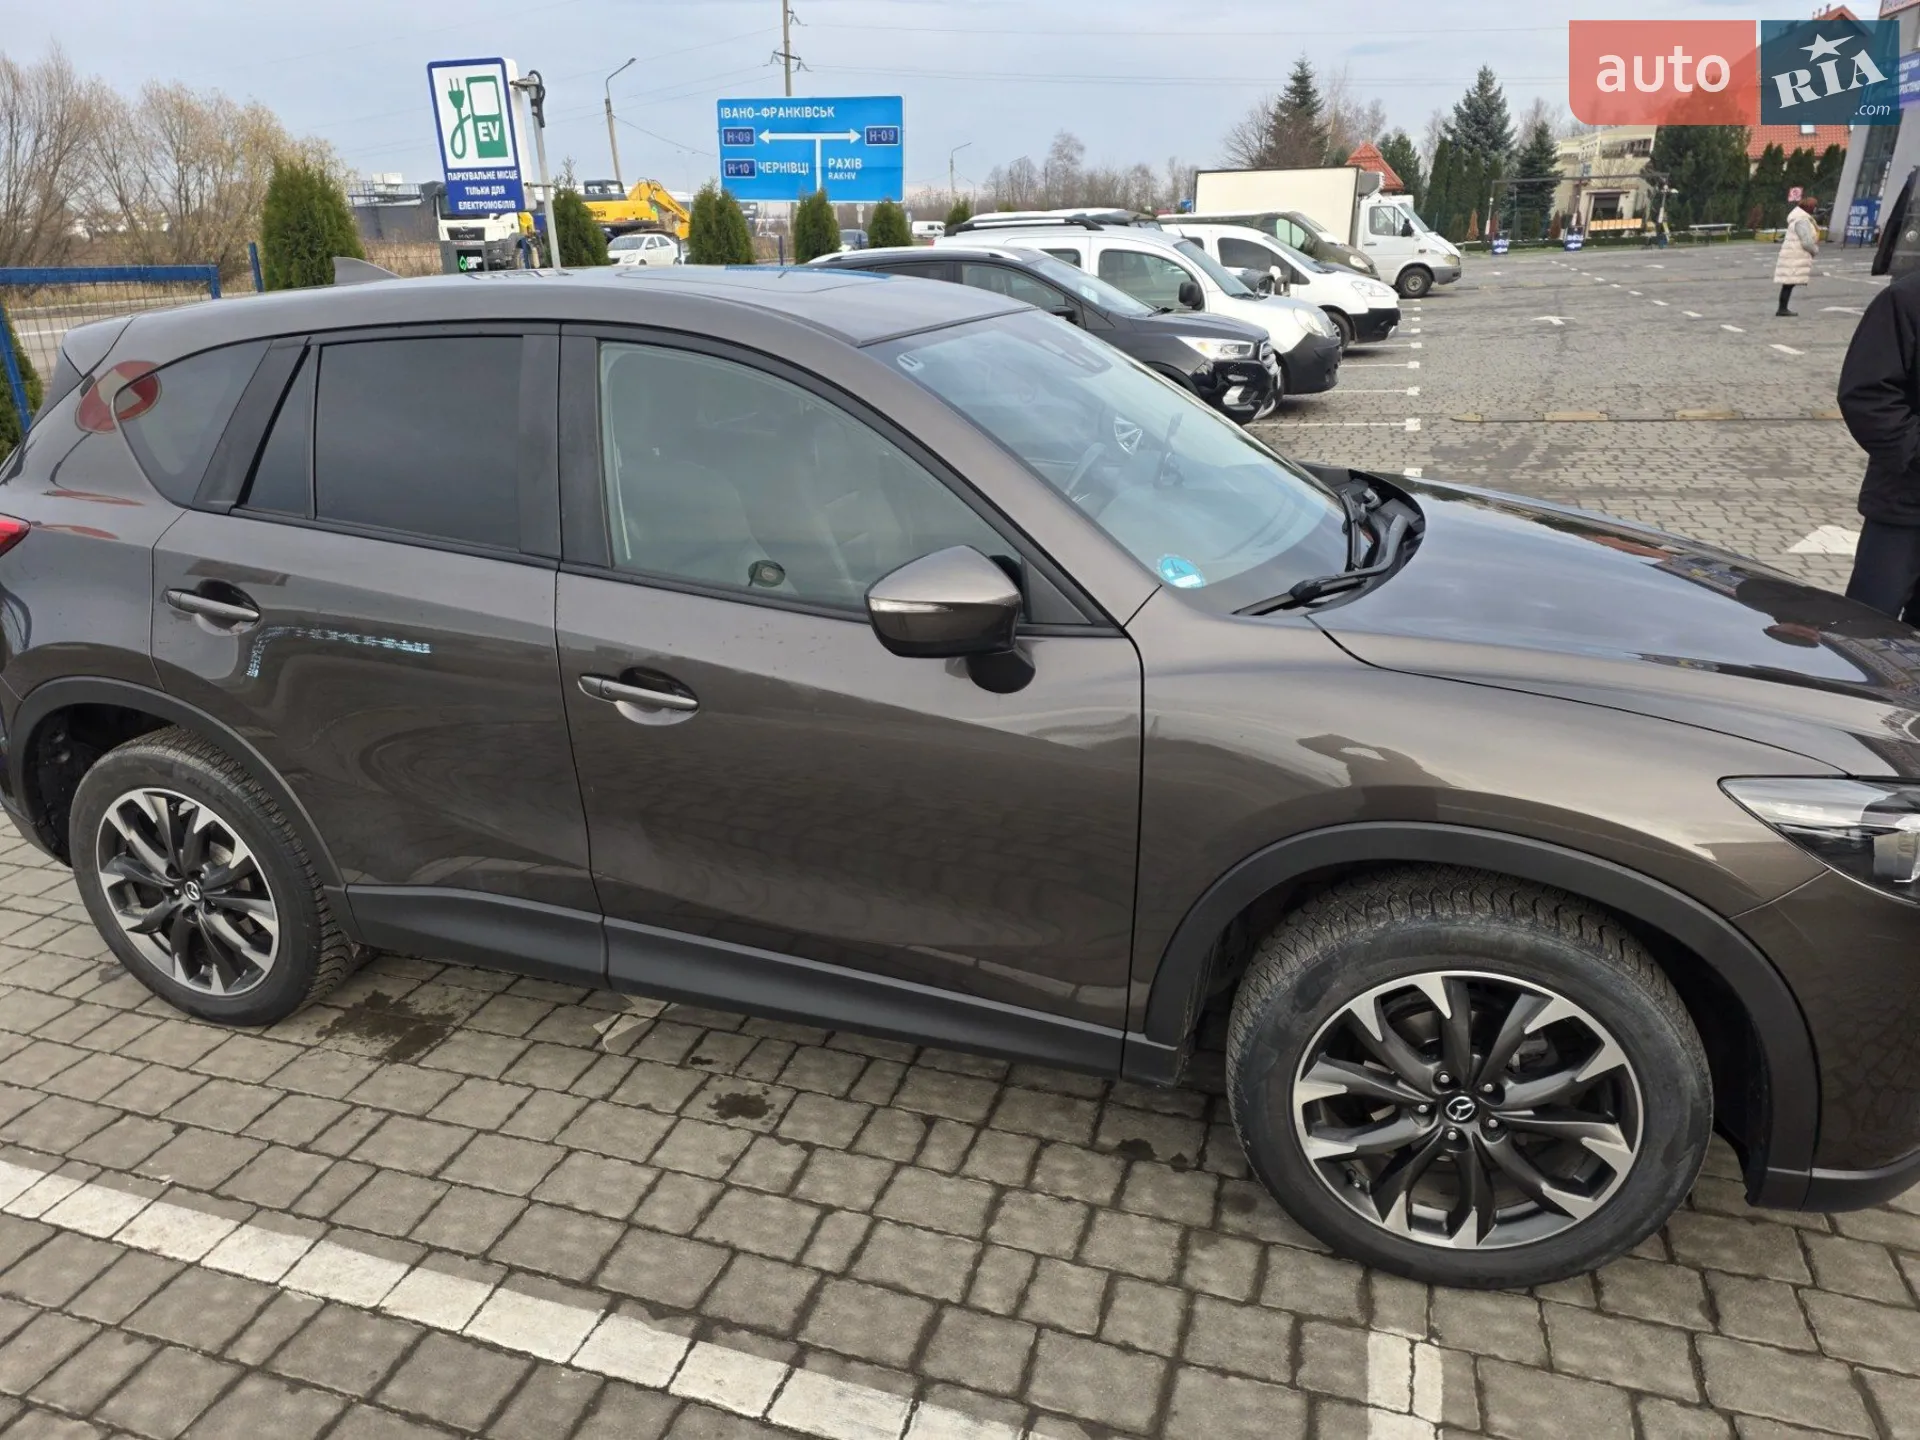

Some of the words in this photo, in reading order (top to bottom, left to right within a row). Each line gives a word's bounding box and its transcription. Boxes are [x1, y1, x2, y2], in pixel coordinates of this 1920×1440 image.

[720, 106, 836, 119] ІВАНО-ФРАНКІВСЬК
[477, 121, 501, 142] EV
[758, 161, 810, 176] ЧЕРНІВЦІ
[828, 157, 863, 170] РАХІВ
[447, 171, 496, 181] ПАРКУВАЛЬНЕ
